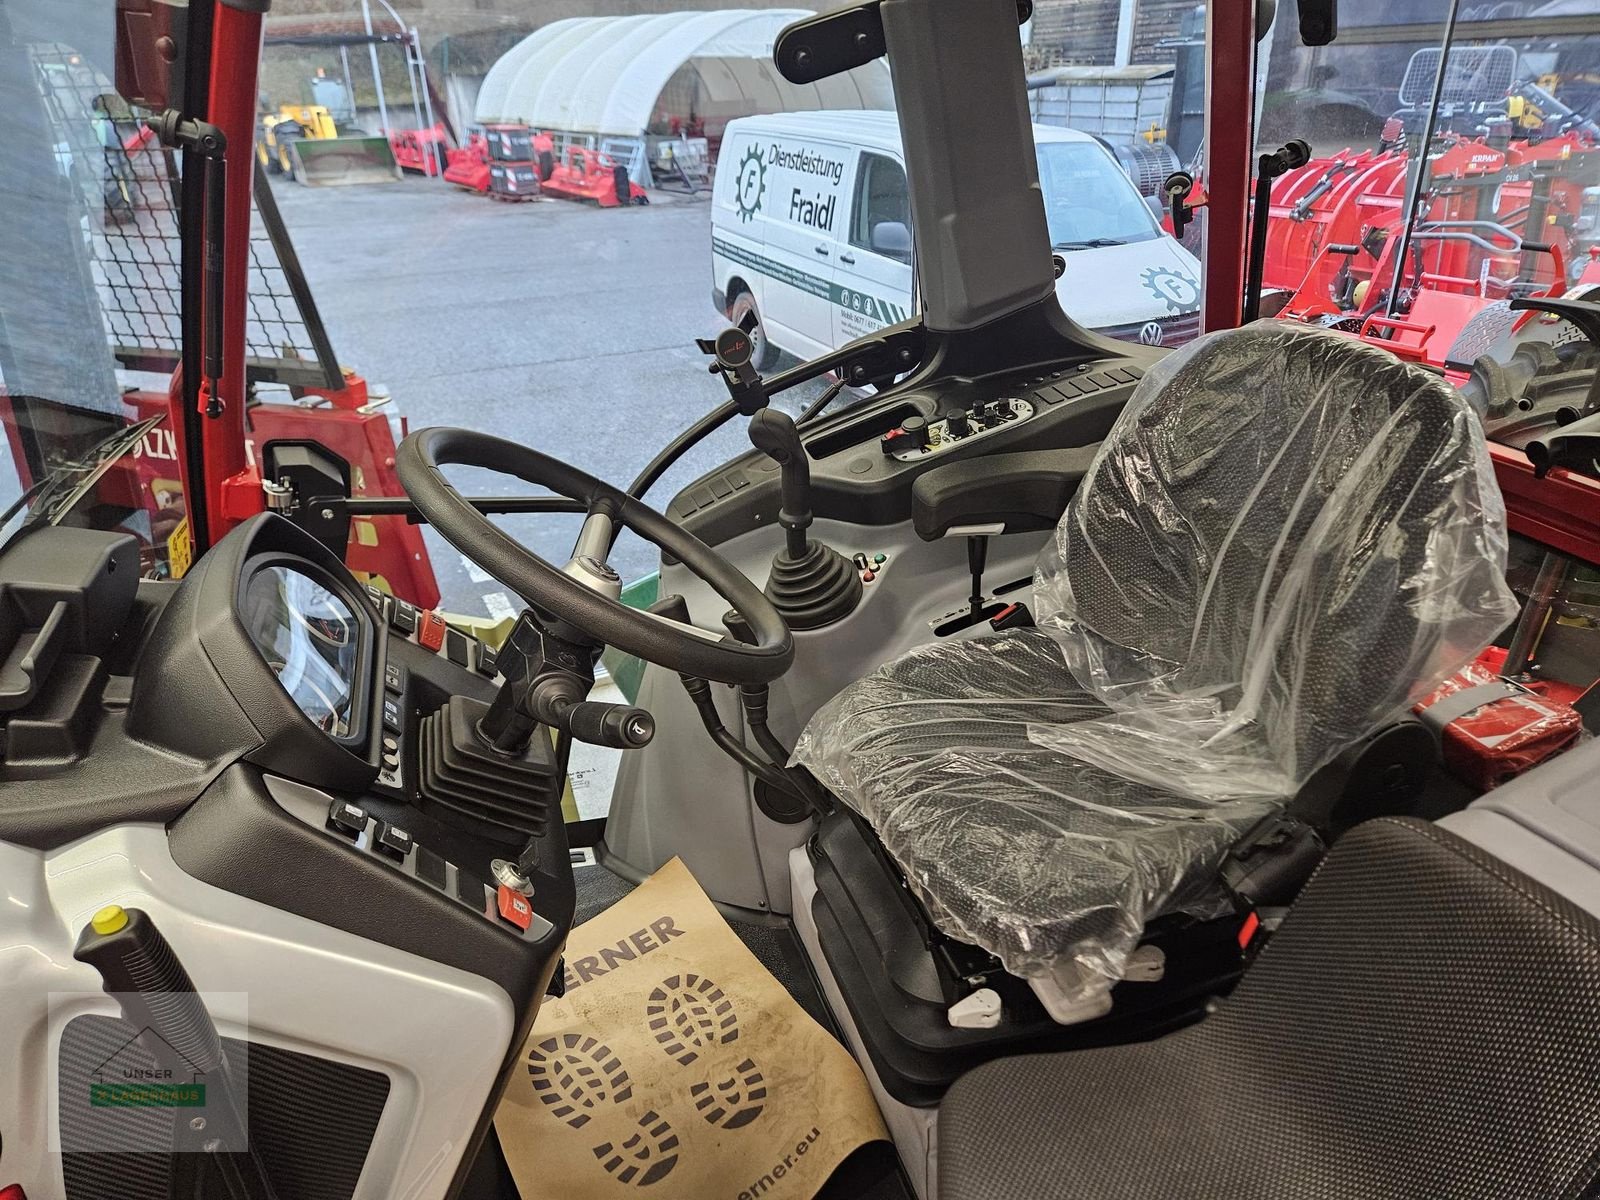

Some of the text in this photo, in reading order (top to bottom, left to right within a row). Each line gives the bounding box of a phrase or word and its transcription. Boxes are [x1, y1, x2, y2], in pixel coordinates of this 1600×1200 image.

[768, 143, 843, 186] Dienstleistung
[1472, 154, 1498, 162] KRPAN
[789, 187, 837, 232] Fraidl
[563, 916, 686, 993] ERNER
[737, 1126, 821, 1200] erner.eu
